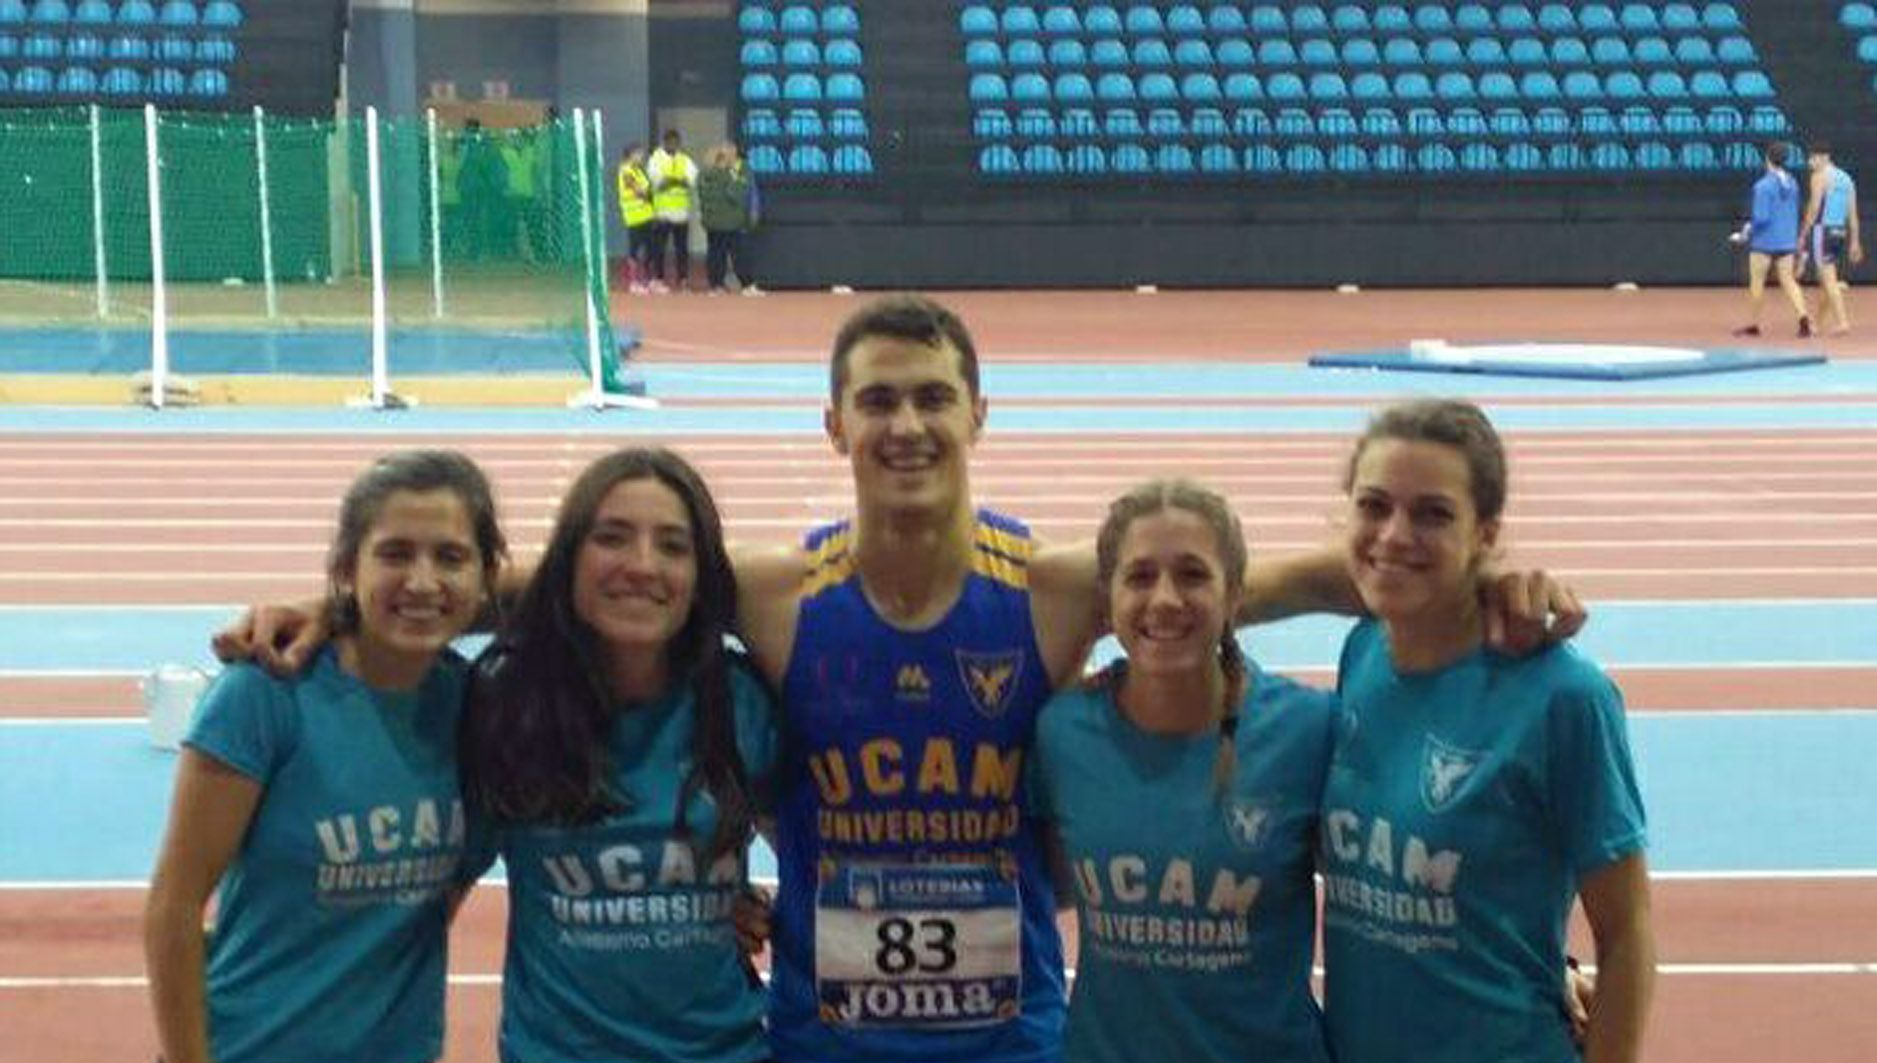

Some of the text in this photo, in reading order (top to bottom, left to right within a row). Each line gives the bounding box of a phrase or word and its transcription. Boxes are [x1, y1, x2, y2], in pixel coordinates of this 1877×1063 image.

[808, 736, 1021, 804] UCAM
[817, 805, 1019, 843] UNIVERSIDAD
[875, 917, 957, 975] 83
